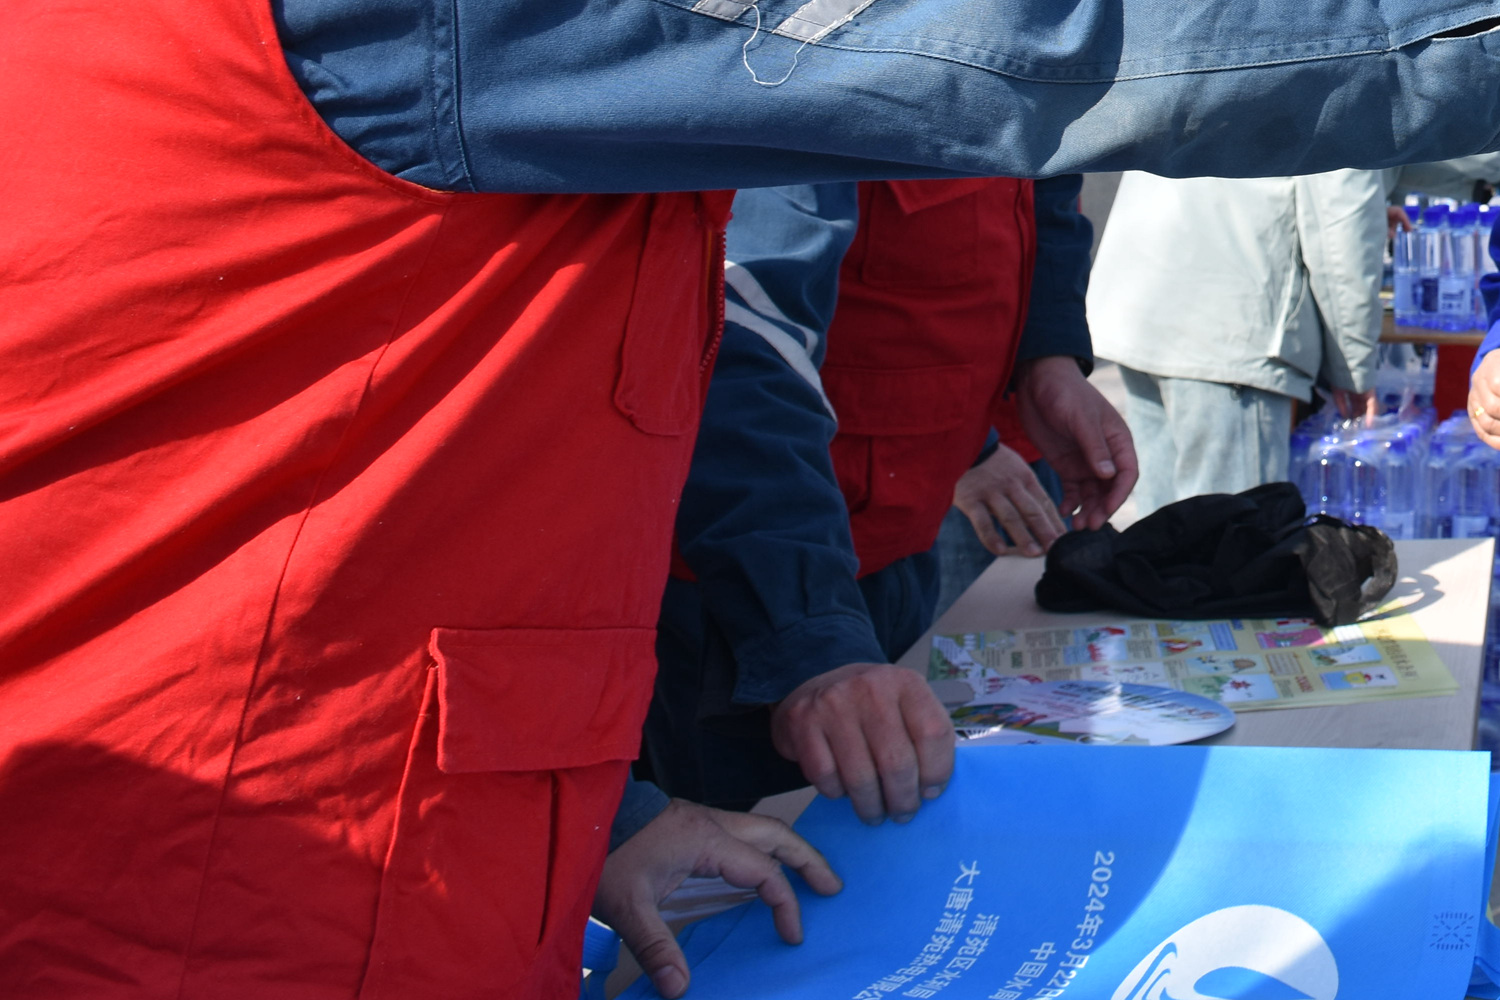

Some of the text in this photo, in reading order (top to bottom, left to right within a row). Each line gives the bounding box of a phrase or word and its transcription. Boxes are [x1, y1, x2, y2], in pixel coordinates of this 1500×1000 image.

[902, 912, 1001, 999] 清苑区水利局
[988, 941, 1057, 1000] 中国水周
